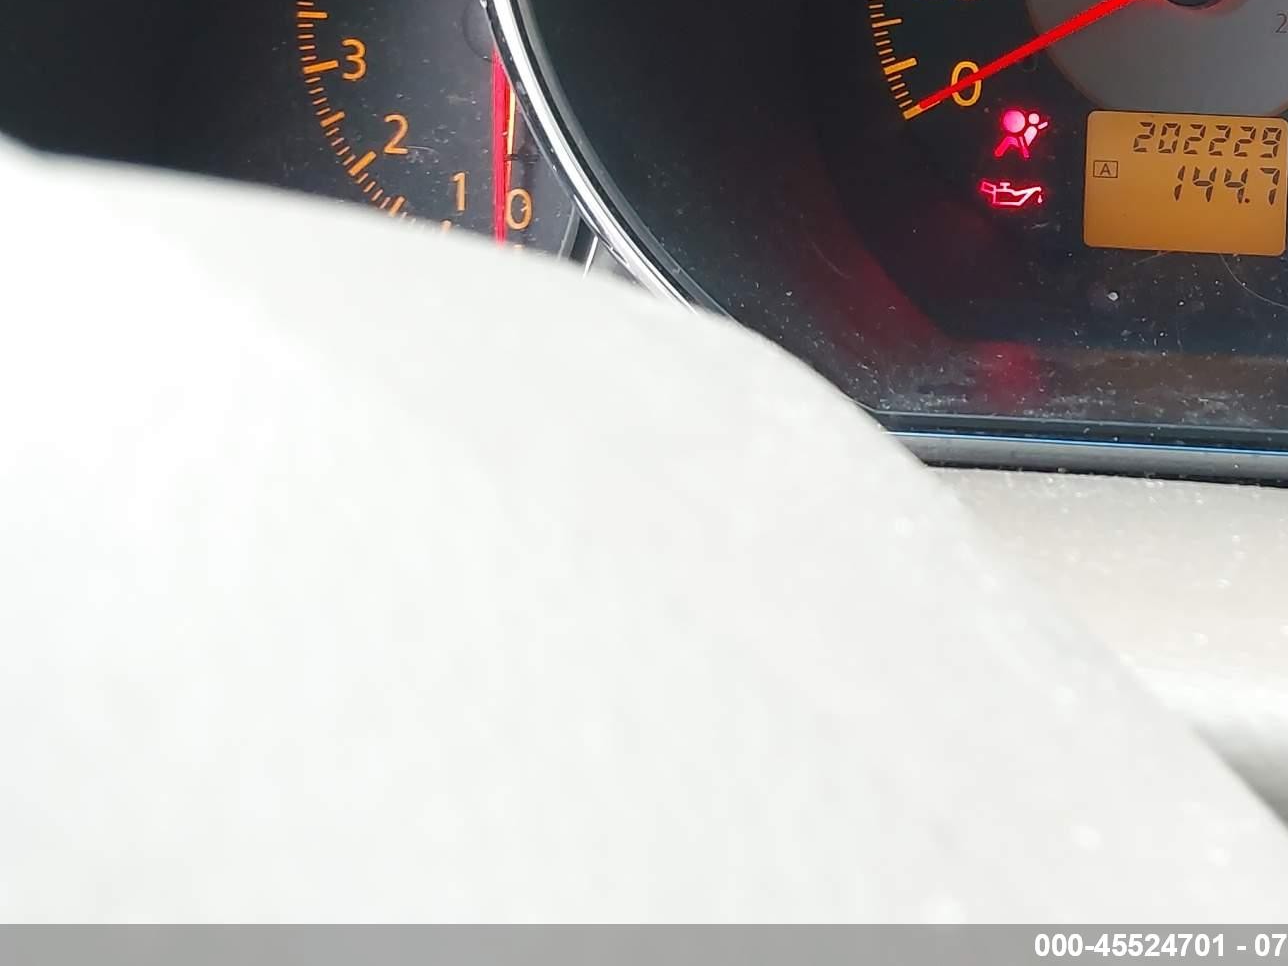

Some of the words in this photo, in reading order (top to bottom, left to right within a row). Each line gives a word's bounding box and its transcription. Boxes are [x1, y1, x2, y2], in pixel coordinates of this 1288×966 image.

[341, 38, 367, 81] 3
[950, 60, 982, 106] 0
[383, 114, 408, 155] 2
[1133, 121, 1282, 158] 202229
[1100, 163, 1112, 176] A
[1173, 165, 1281, 206] 144.7
[452, 172, 467, 212] 1
[505, 188, 533, 230] 0
